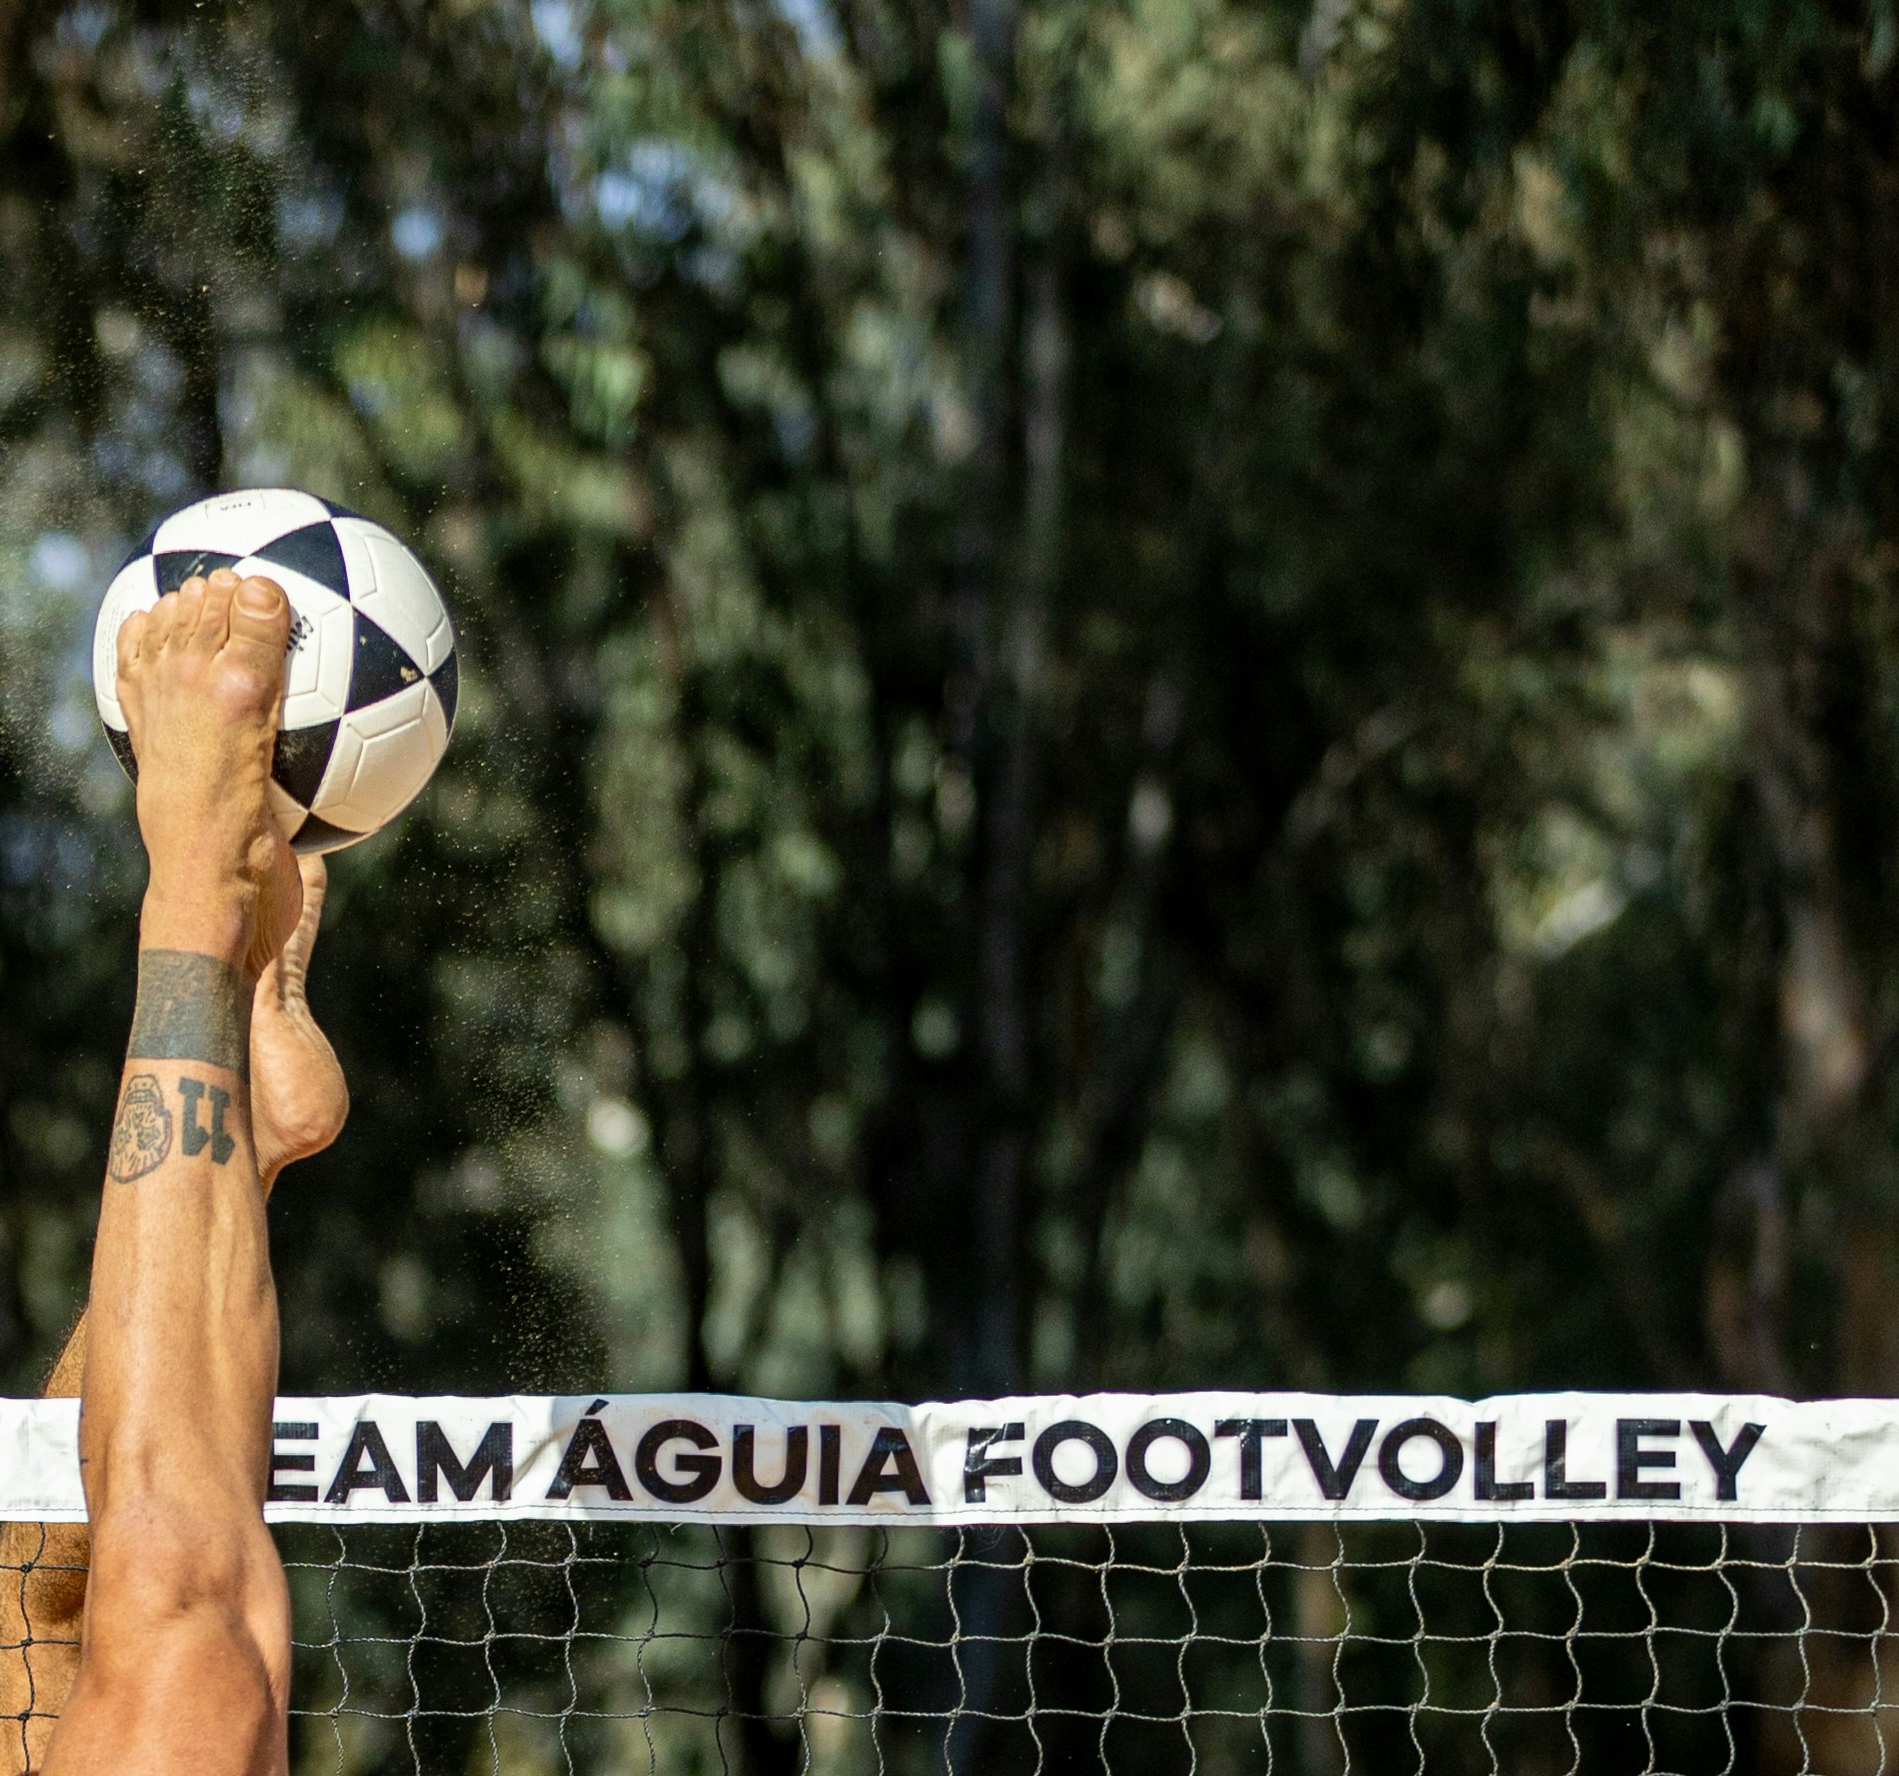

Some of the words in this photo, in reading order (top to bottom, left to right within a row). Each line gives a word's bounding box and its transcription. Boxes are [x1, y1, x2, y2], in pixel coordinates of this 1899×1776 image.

[266, 1419, 514, 1504] EAM
[544, 1398, 933, 1507] ÁGUIA
[962, 1417, 1767, 1504] FOOTVOLLEY
